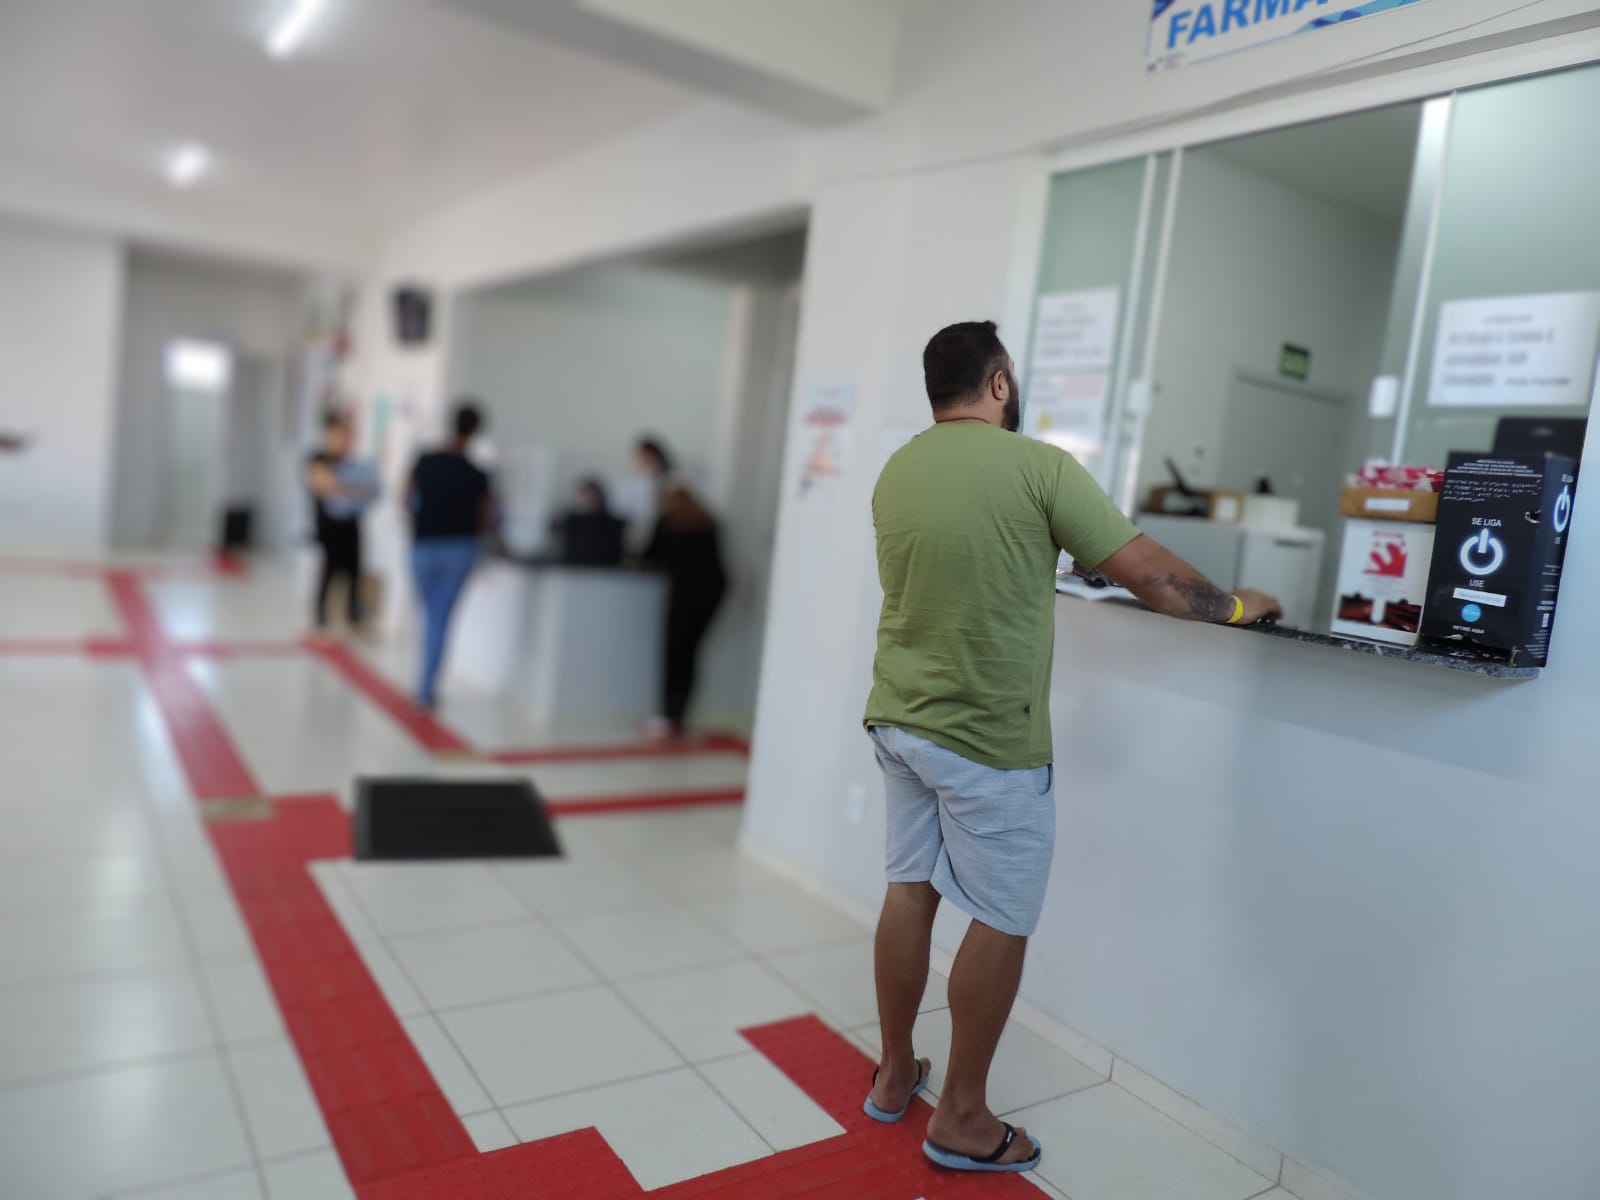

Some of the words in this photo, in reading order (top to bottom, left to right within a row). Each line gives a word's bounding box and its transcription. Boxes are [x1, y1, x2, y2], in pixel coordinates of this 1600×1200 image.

[1472, 517, 1482, 526] SE
[1483, 518, 1501, 527] LIGA
[1469, 579, 1485, 588] USE
